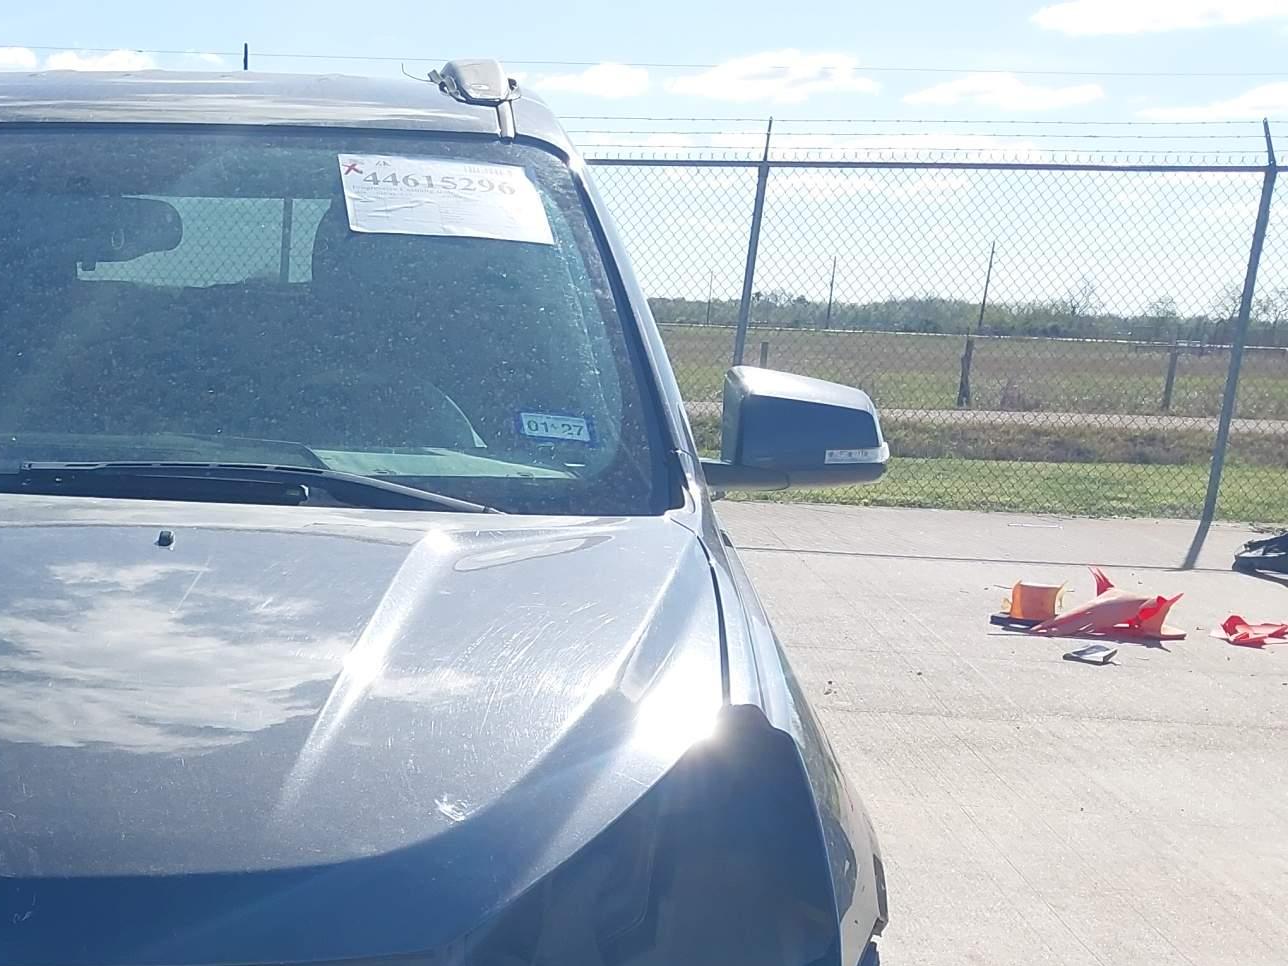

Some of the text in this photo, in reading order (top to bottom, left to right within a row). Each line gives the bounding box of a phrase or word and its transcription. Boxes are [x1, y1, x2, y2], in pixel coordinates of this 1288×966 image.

[362, 171, 516, 195] 44615296
[527, 420, 584, 436] 01 27
